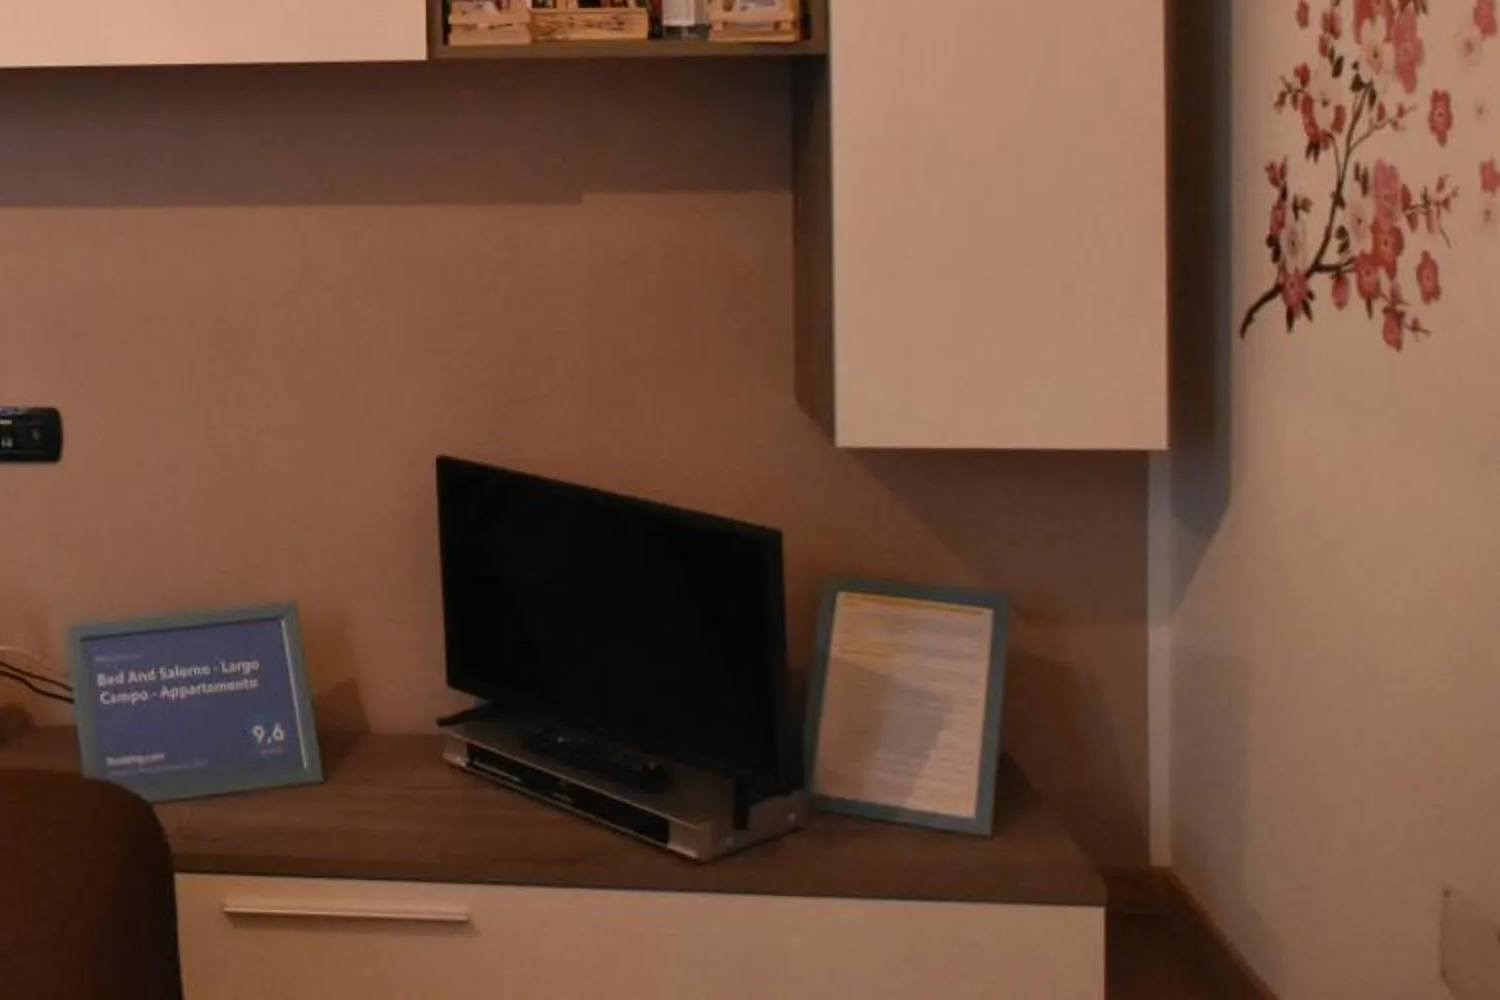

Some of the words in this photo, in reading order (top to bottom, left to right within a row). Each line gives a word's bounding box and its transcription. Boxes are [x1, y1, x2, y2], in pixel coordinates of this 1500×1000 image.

[97, 671, 124, 687] Bed
[128, 668, 156, 683] And
[159, 664, 211, 680] Salerno
[220, 660, 260, 675] Largo
[100, 690, 149, 706] Campo
[161, 678, 259, 700] Appartamento
[252, 723, 285, 744] 9,6
